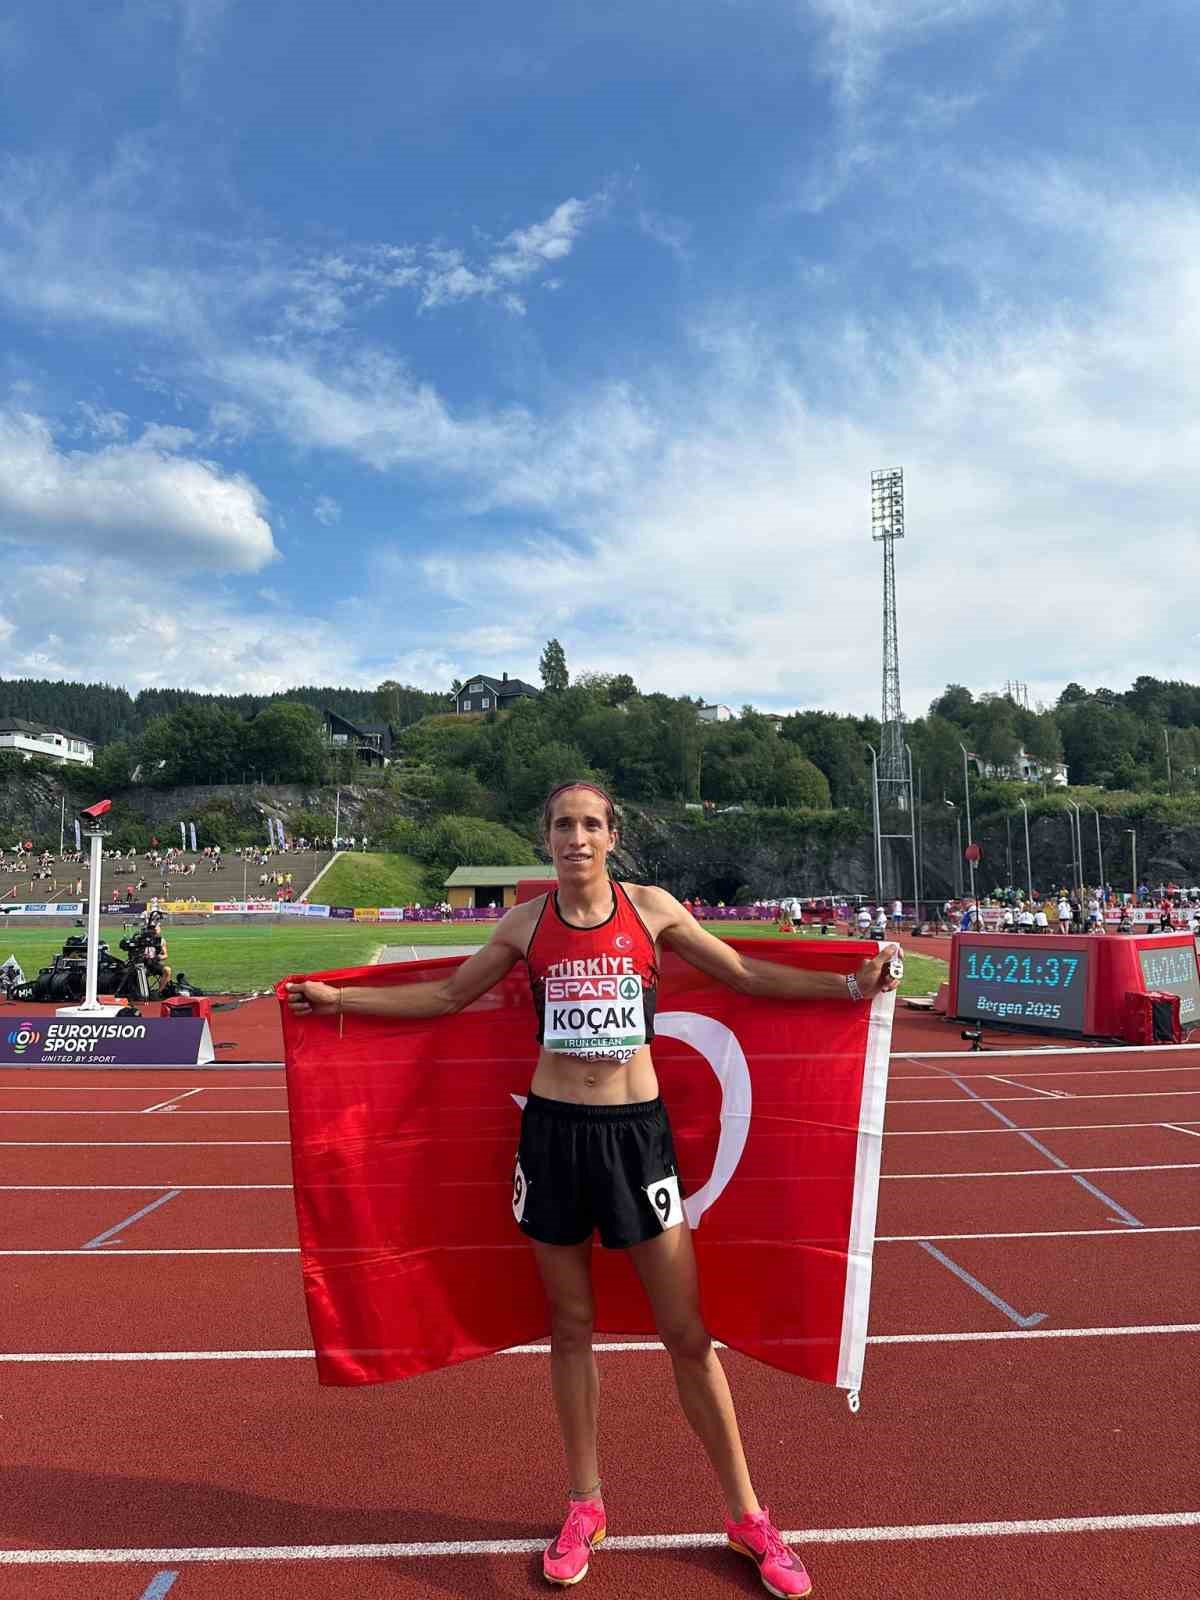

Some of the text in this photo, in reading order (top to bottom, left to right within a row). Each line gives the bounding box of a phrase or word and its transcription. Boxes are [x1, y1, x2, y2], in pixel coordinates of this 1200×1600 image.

[547, 953, 634, 977] TÜRKİYE
[966, 953, 1079, 988] 16:21:37
[549, 981, 616, 998] SPAR
[976, 996, 1062, 1019] Bergen 2025
[47, 1024, 146, 1039] EUROVISION
[553, 1007, 636, 1035] KOÇAK
[43, 1038, 99, 1052] SPORT
[569, 1038, 589, 1048] RUN
[590, 1037, 623, 1047] CLEAN
[41, 1055, 117, 1063] UNITED BY SPORT
[513, 1174, 523, 1206] 9
[654, 1187, 671, 1222] 9
